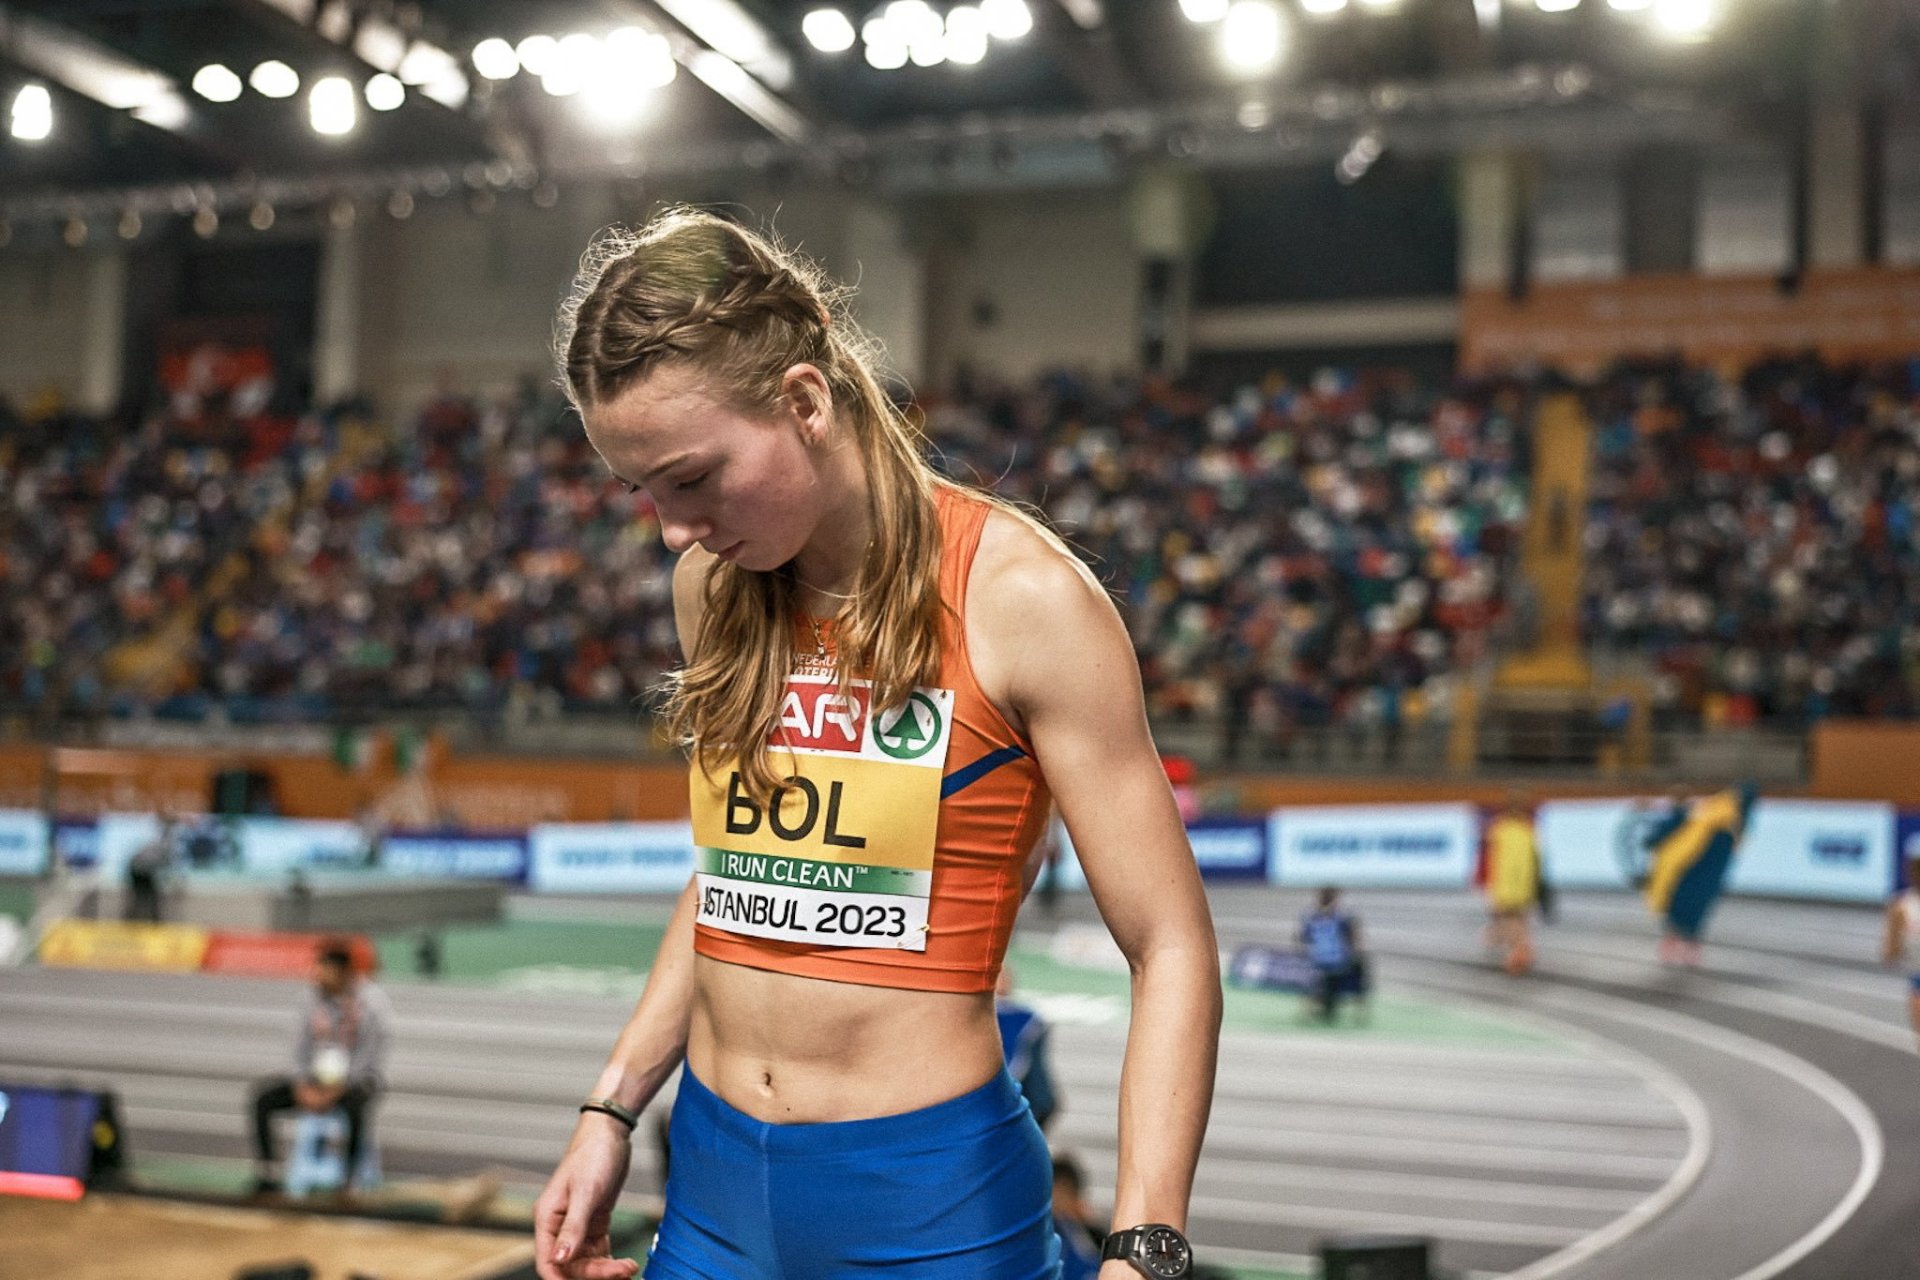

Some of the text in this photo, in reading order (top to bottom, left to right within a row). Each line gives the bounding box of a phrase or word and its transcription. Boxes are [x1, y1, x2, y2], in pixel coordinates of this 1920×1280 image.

[769, 691, 862, 742] AR
[726, 771, 867, 849] BOL
[721, 853, 726, 874] I
[728, 854, 768, 879] RUN
[703, 886, 906, 938] ISTANBUL 2023
